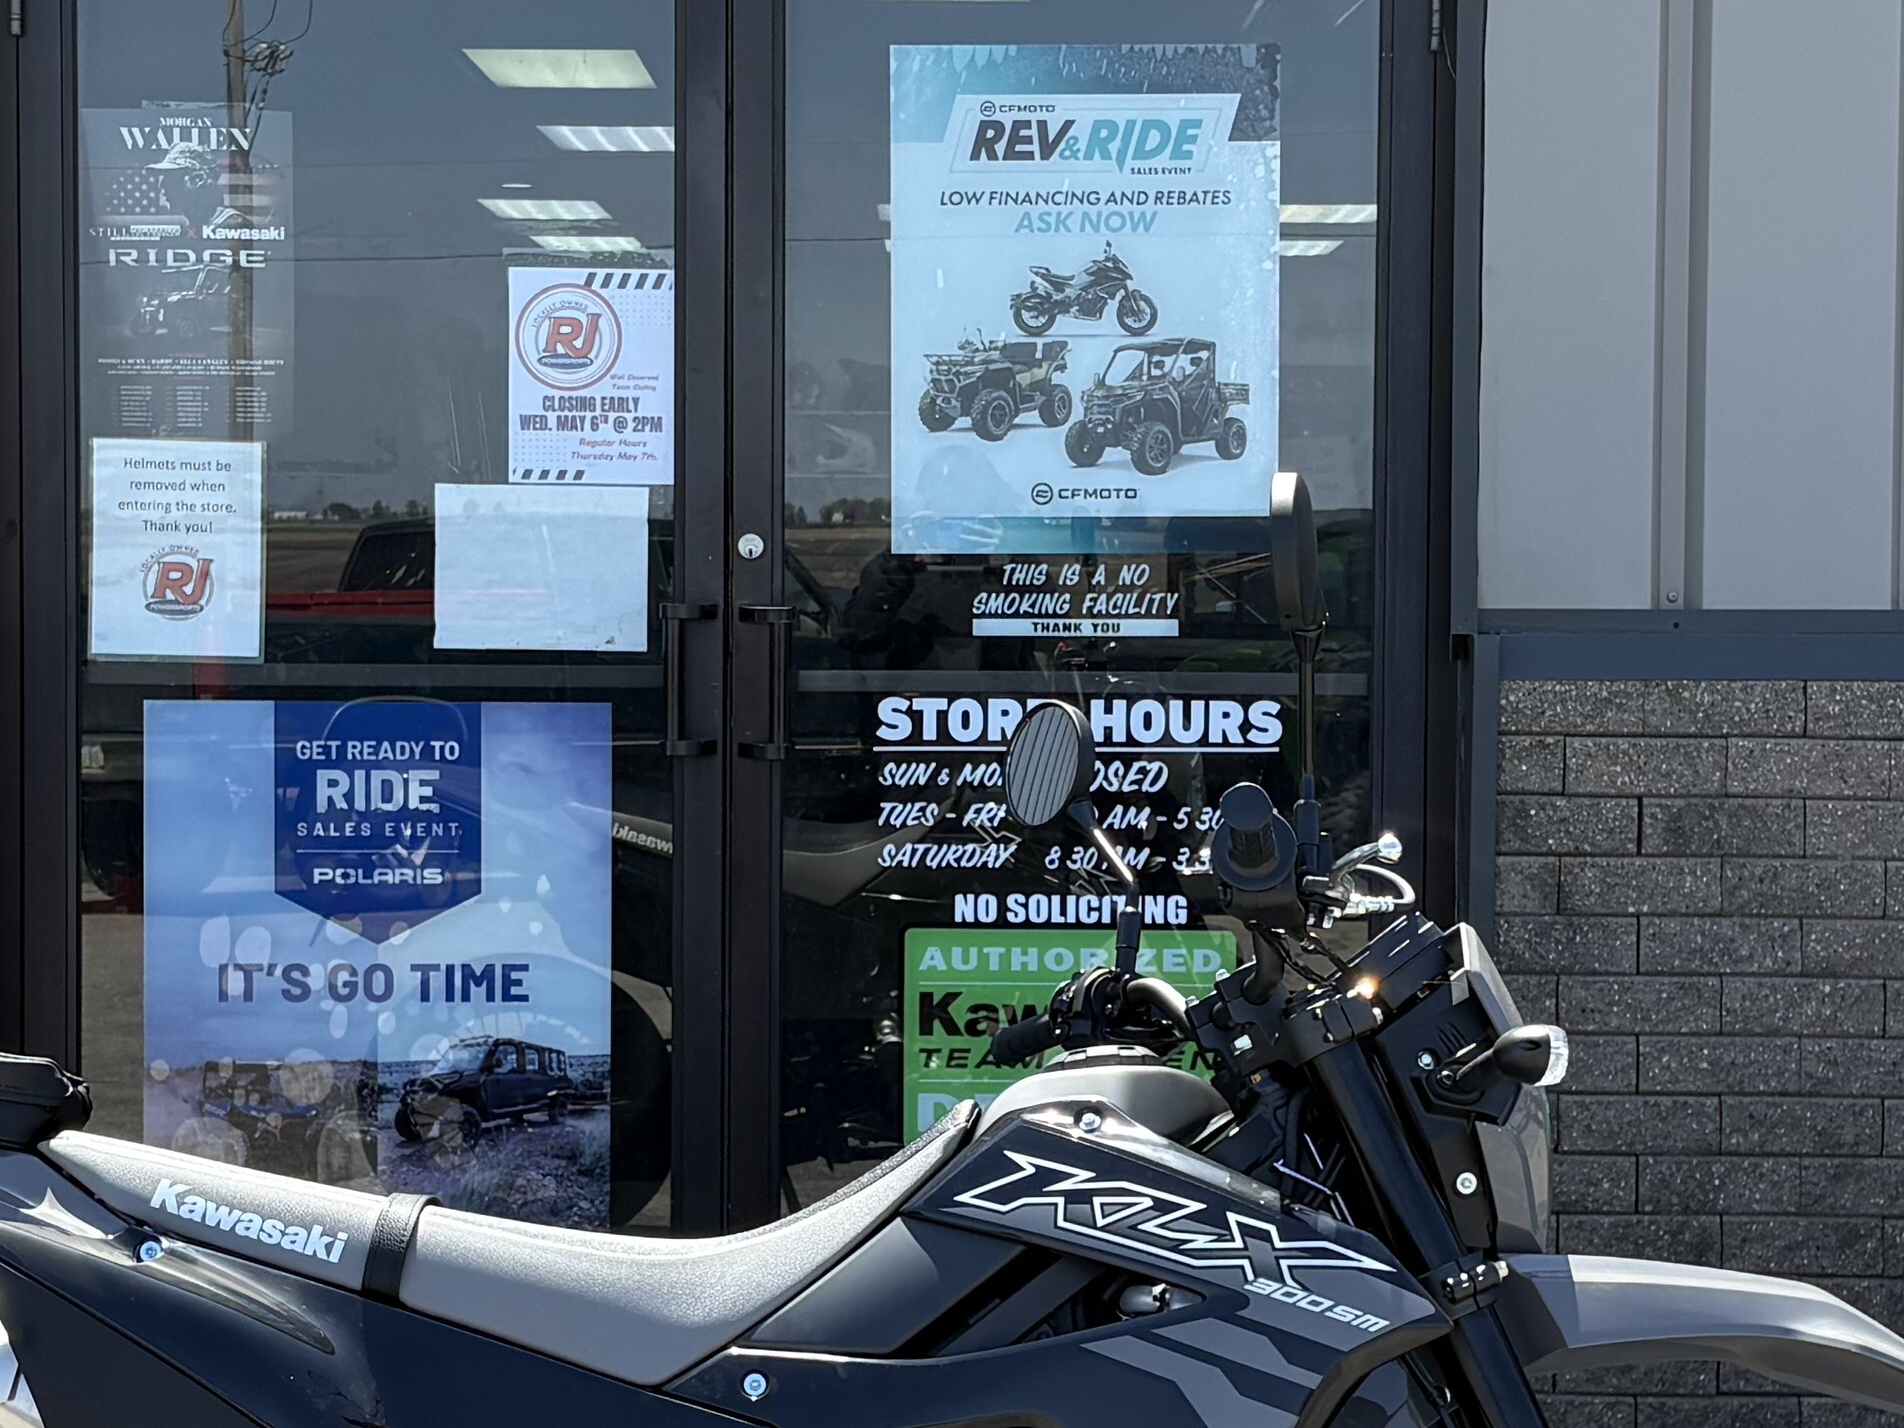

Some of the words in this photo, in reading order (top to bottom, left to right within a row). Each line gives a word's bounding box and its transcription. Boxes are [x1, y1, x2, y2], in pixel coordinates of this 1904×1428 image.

[1130, 167, 1158, 176] SALES
[1161, 167, 1192, 176] EVENT
[940, 190, 986, 206] LOW
[988, 190, 1102, 206] FINANCING
[1104, 190, 1150, 206] AND
[1153, 190, 1232, 206] REBATES
[1014, 210, 1075, 234] ASK
[1078, 210, 1159, 234] NOW
[202, 225, 285, 240] Kawasaki
[108, 248, 267, 268] RIDGE
[542, 313, 602, 358] RJ
[542, 395, 596, 413] CLOSING
[600, 396, 640, 414] EARLY
[519, 414, 552, 432] WED.
[556, 414, 586, 432] MAY
[613, 416, 628, 434] @
[632, 416, 663, 433] 2PM
[579, 438, 616, 448] Regular
[618, 438, 648, 448] Hours
[124, 458, 176, 471] Helmets
[180, 461, 212, 472] must
[216, 460, 232, 472] be
[571, 450, 614, 462] Thursday
[617, 452, 638, 462] May
[130, 480, 186, 492] removed
[190, 480, 226, 492] when
[1057, 488, 1138, 500] CFMOTO
[118, 500, 172, 514] entering
[176, 500, 196, 512] the
[200, 502, 238, 514] store.
[142, 520, 181, 532] Thank
[150, 558, 215, 606] RJ
[1002, 564, 1048, 586] THIS
[1058, 564, 1082, 586] IS
[1092, 564, 1106, 586] A
[1118, 564, 1150, 586] NO
[972, 592, 1071, 615] SMOKING
[1082, 592, 1179, 615] FACILITY
[1032, 622, 1083, 633] THANK
[1092, 622, 1122, 634] YOU
[875, 696, 1054, 743] STOR
[1089, 698, 1284, 745] HOURS
[295, 740, 342, 760] GET
[346, 740, 425, 760] READY
[430, 740, 461, 760] TO
[878, 761, 936, 788] SUN
[937, 768, 950, 785] &
[956, 762, 1003, 787] MO
[1089, 760, 1169, 793] SED
[315, 768, 441, 814] RIDE
[878, 802, 940, 828] TUES
[1102, 804, 1151, 830] AM
[296, 822, 372, 837] SALES
[384, 822, 460, 838] EVENT
[877, 842, 1017, 869] SATURDAY
[1045, 846, 1061, 870] 8
[1066, 846, 1098, 870] 30
[312, 866, 444, 886] POLARIS
[954, 893, 997, 924] NO
[1006, 894, 1188, 925] SOLICITNG
[918, 946, 1223, 973] AUTHORZED
[217, 962, 313, 1004] IT'S
[328, 962, 395, 1004] GO
[410, 962, 531, 1004] TIME
[149, 1178, 350, 1264] Kawasaki
[954, 1149, 1398, 1289] KLX
[1243, 1275, 1392, 1333] 300SM
